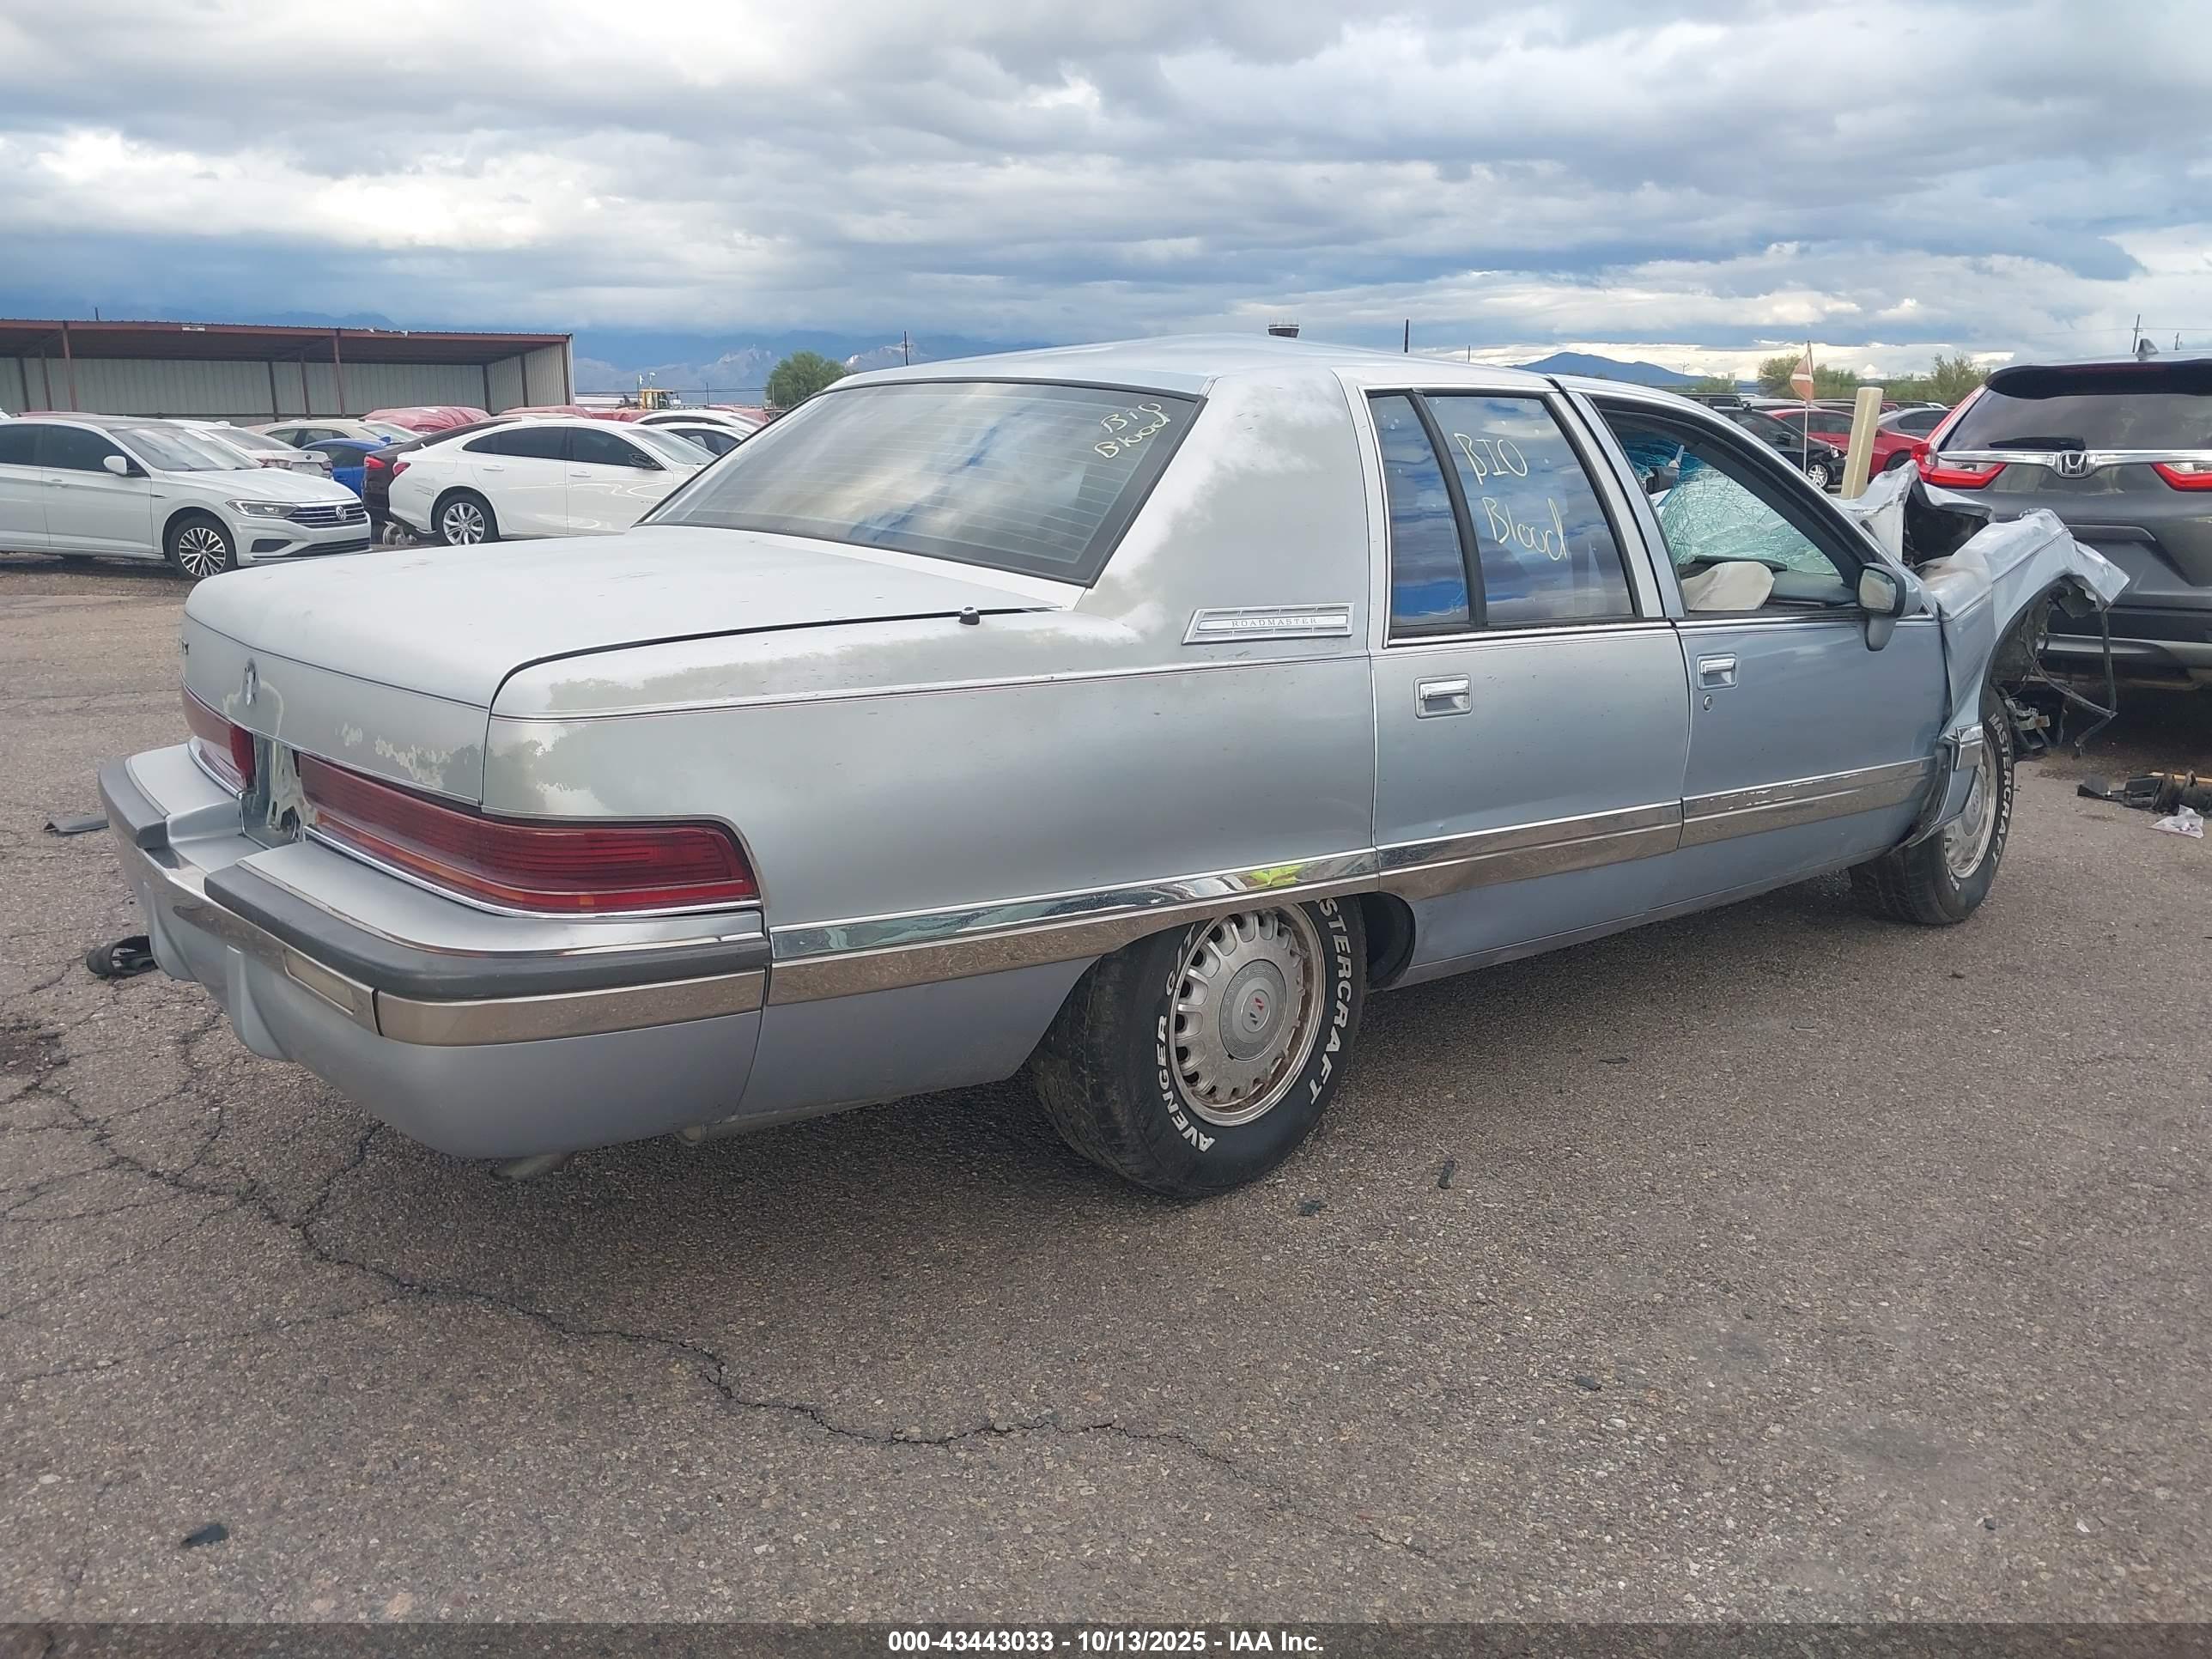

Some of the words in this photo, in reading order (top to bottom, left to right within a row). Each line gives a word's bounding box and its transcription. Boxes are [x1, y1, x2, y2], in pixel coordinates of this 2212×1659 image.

[1454, 432, 1528, 485] BIO
[1482, 496, 1567, 561] Blood
[1231, 617, 1318, 628] ROADMASTER
[1988, 713, 2012, 866] MASTERCRAFT
[1309, 896, 1352, 1106] STERCRAFT
[1157, 1015, 1216, 1152] AVENGER
